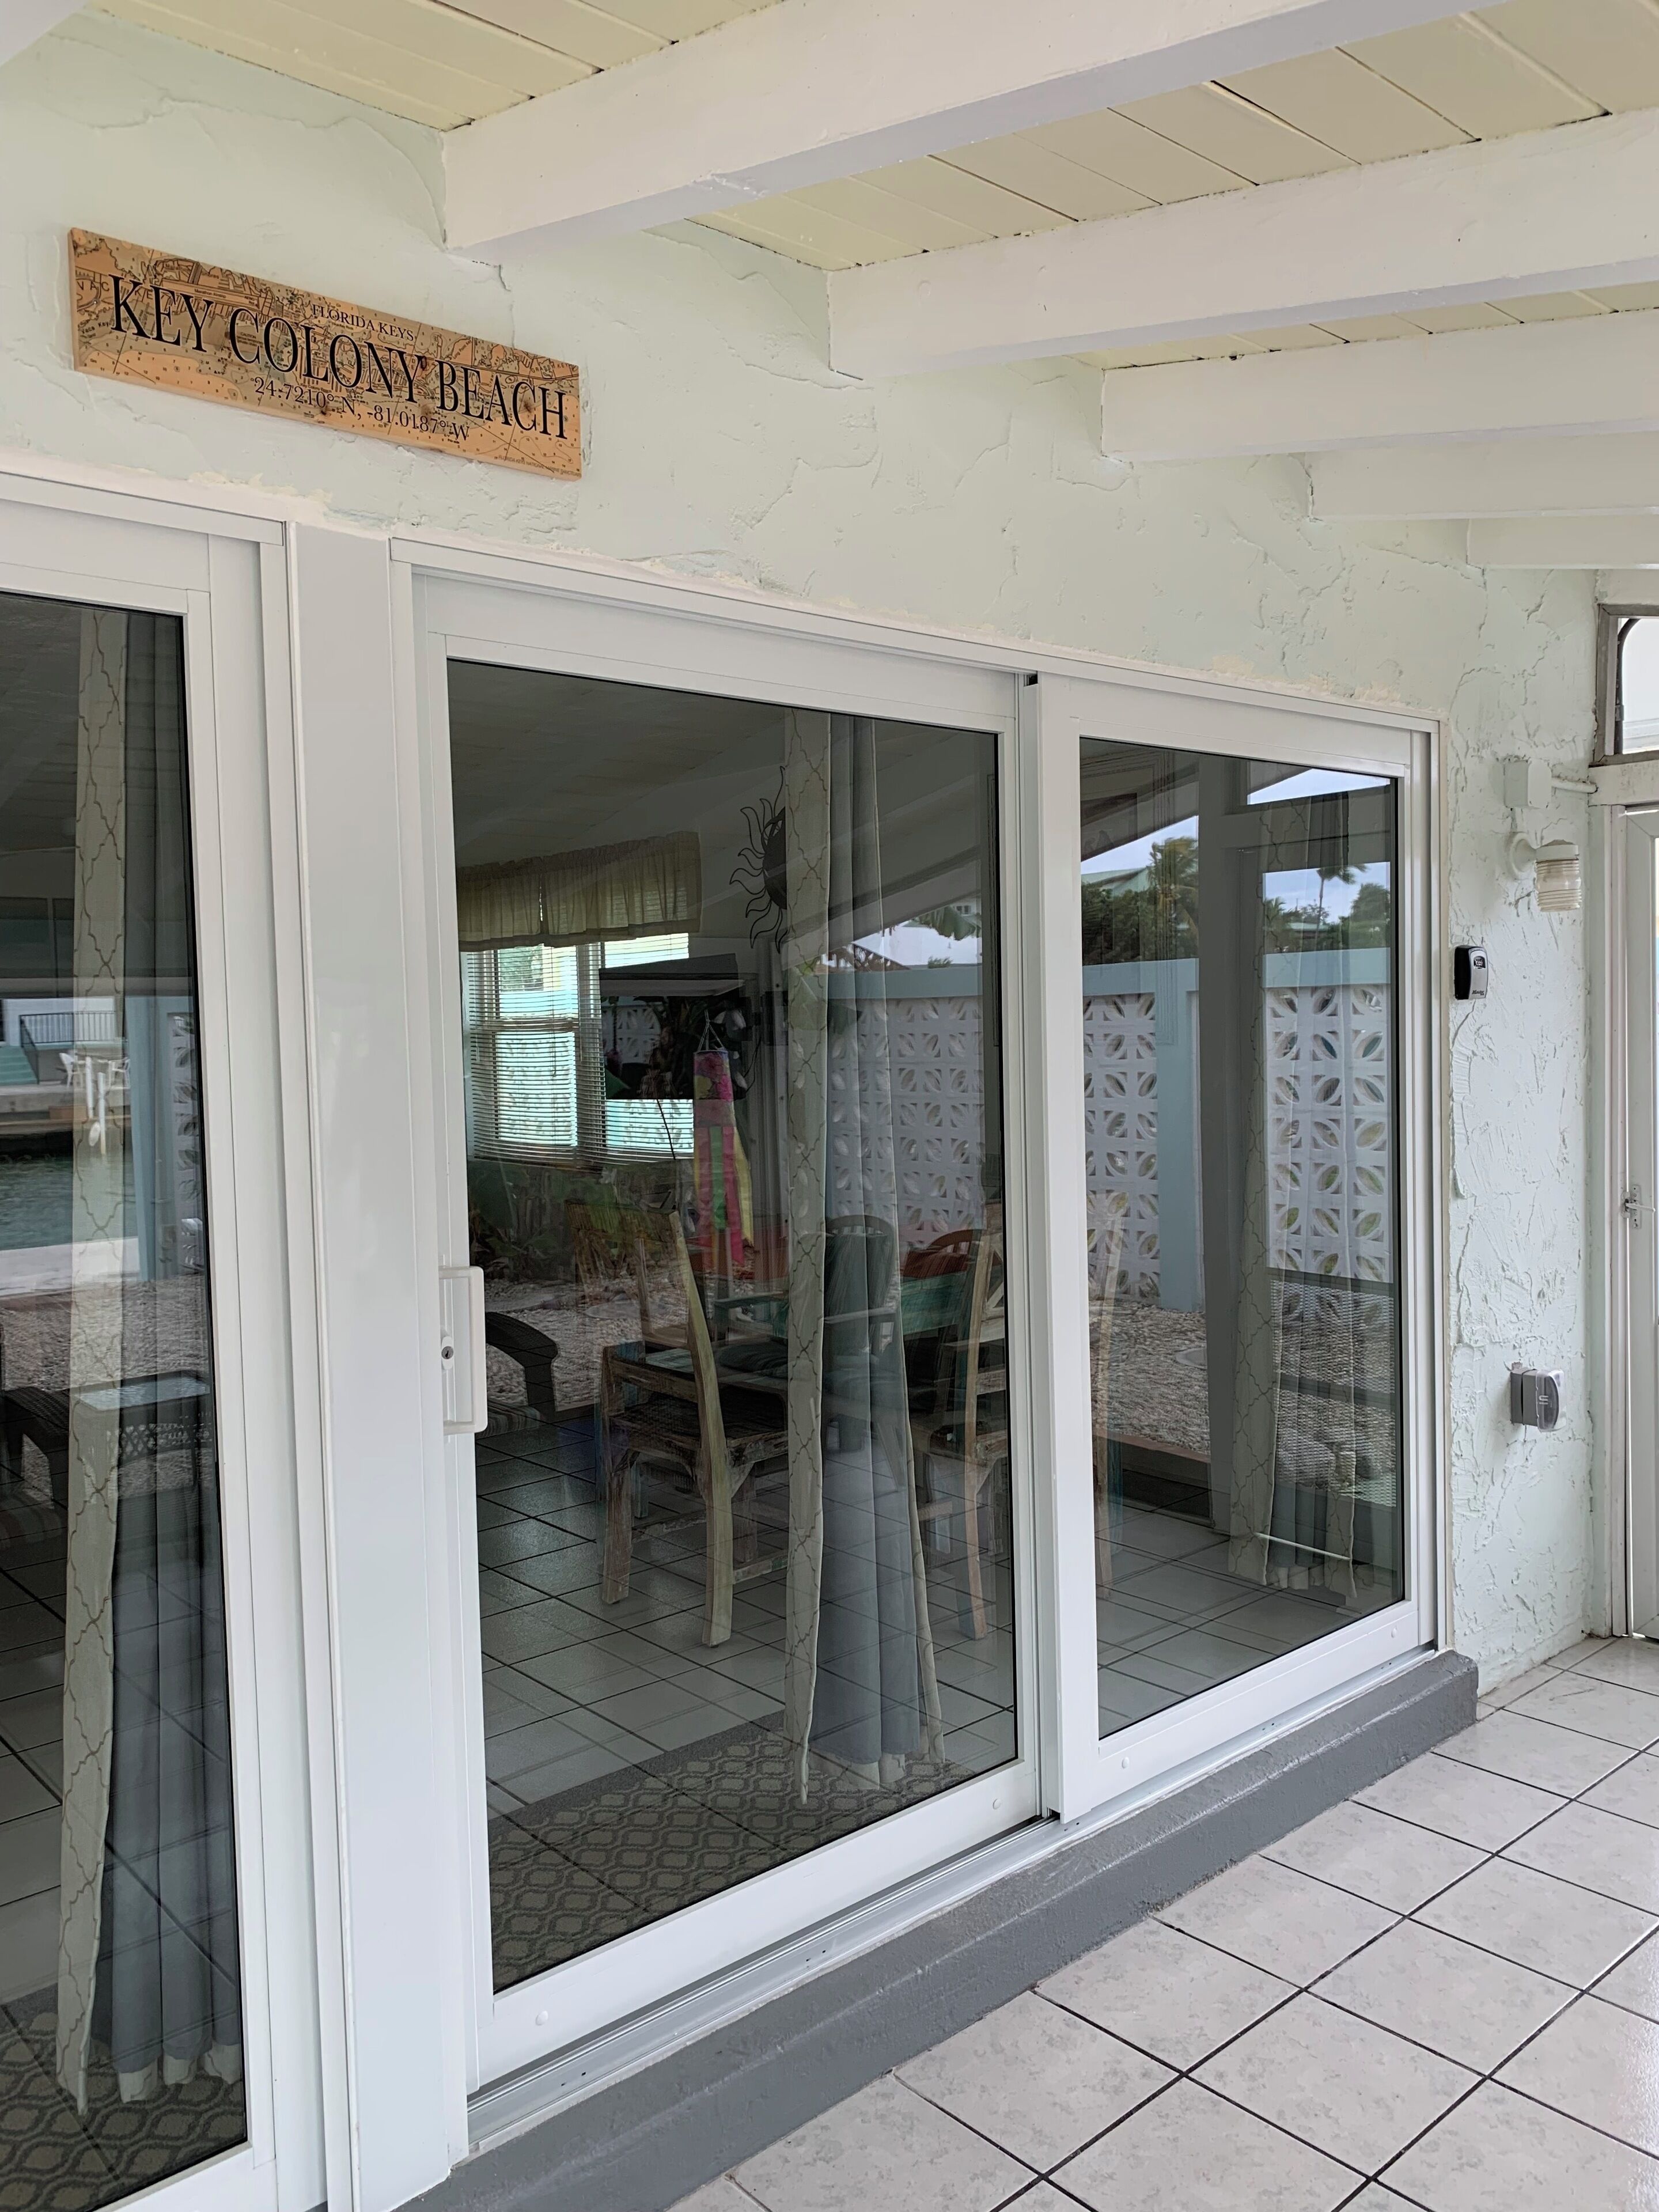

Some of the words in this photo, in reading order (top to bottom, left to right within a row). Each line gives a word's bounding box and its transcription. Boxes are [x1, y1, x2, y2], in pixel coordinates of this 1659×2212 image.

[312, 304, 375, 331] FLORIDA
[378, 321, 414, 342] KEYS
[108, 274, 214, 353] KEY
[230, 308, 425, 404] COLONY
[434, 359, 567, 440] BEACH
[255, 376, 334, 408] 24.7210°
[341, 396, 362, 421] N,
[367, 404, 446, 434] -81.0187°
[452, 422, 470, 441] W
